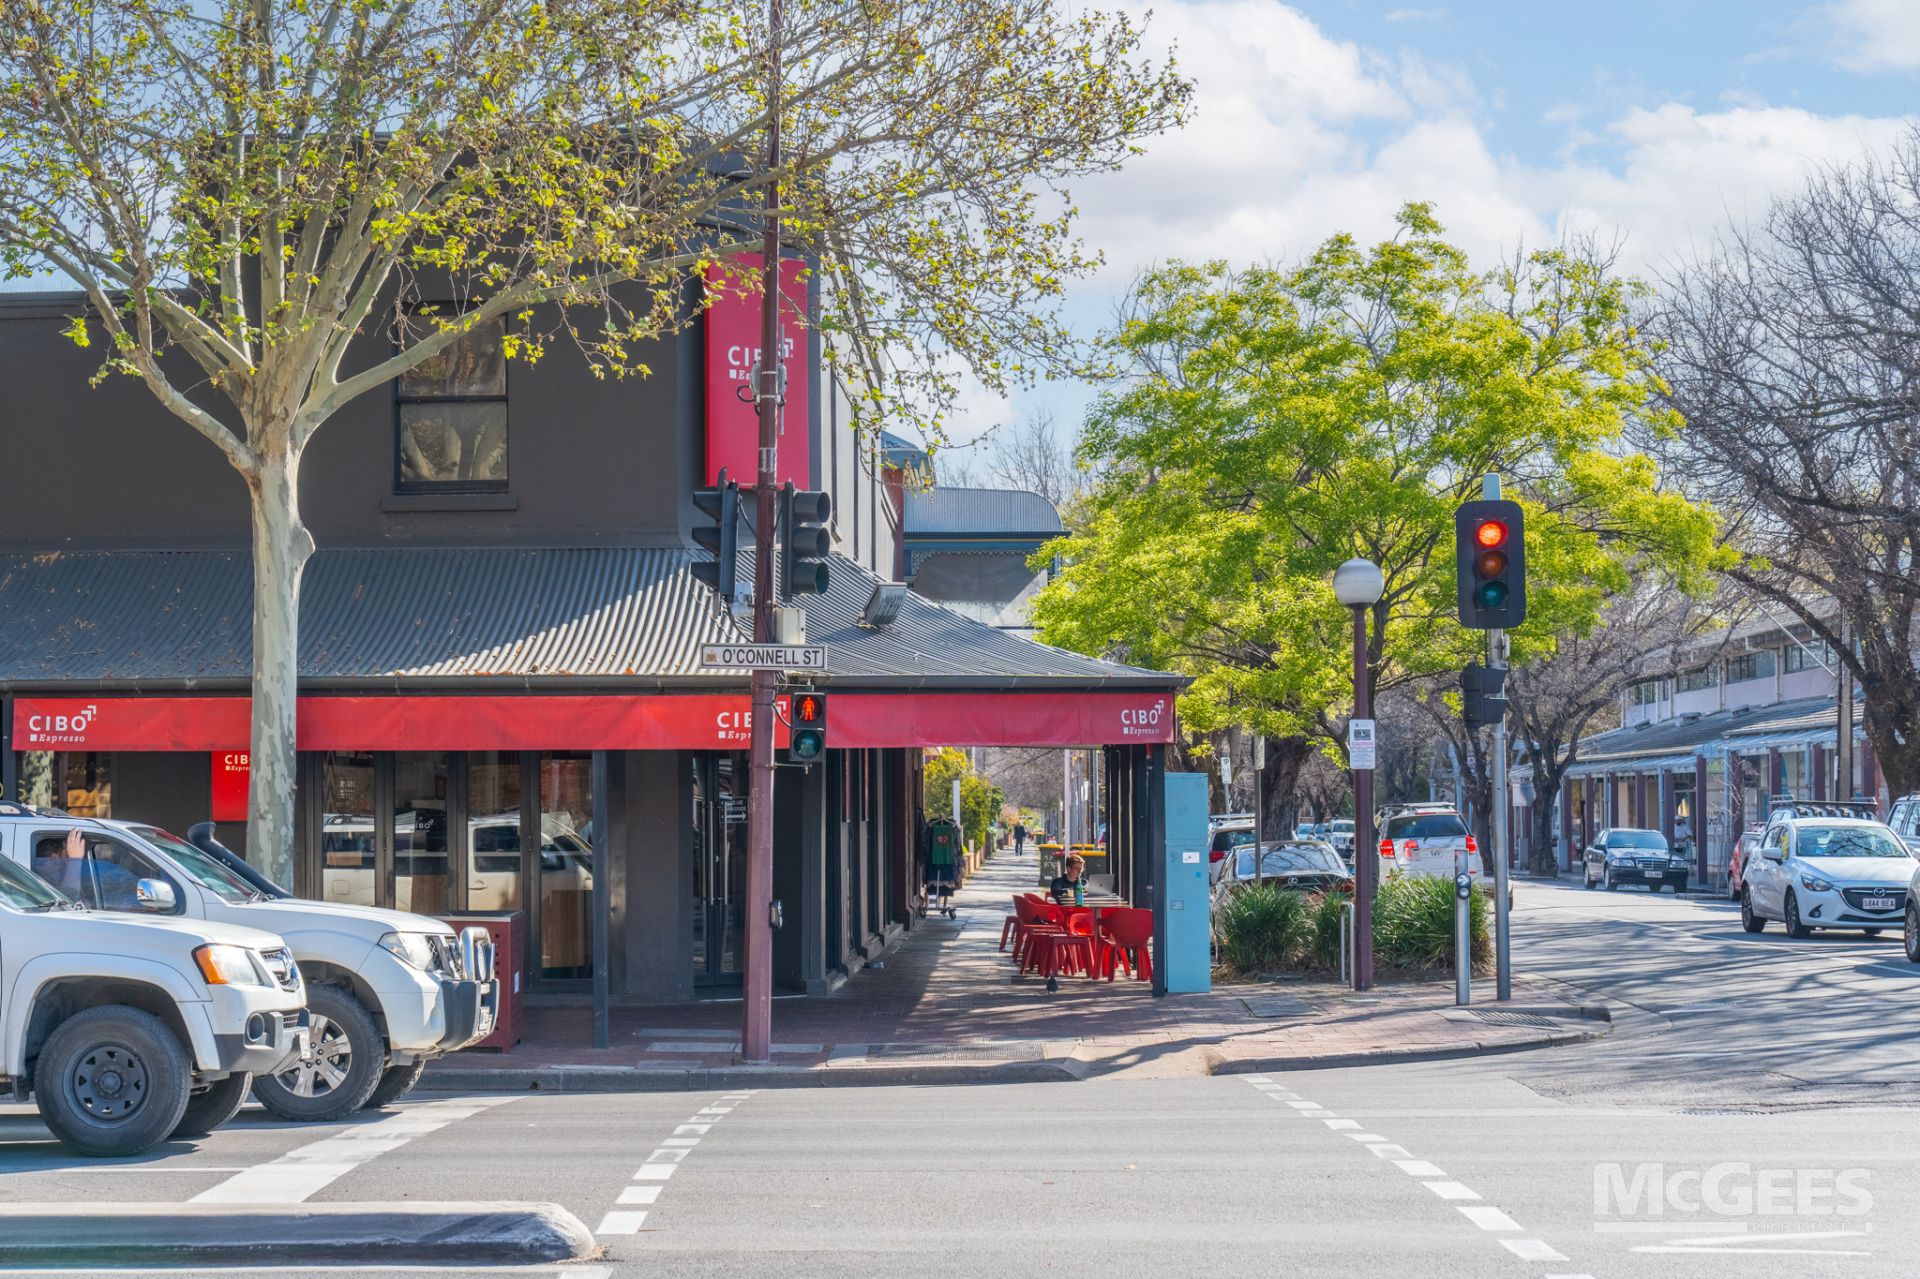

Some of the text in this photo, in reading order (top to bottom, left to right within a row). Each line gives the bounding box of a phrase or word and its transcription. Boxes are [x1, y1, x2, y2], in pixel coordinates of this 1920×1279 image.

[722, 648, 819, 665] O'CONNELL ST
[29, 715, 86, 731] CIBO
[717, 711, 752, 728] CIB
[1121, 709, 1158, 724] CIBO
[39, 733, 85, 743] Espresso
[1129, 726, 1160, 736] Espresso
[224, 754, 250, 765] CIB
